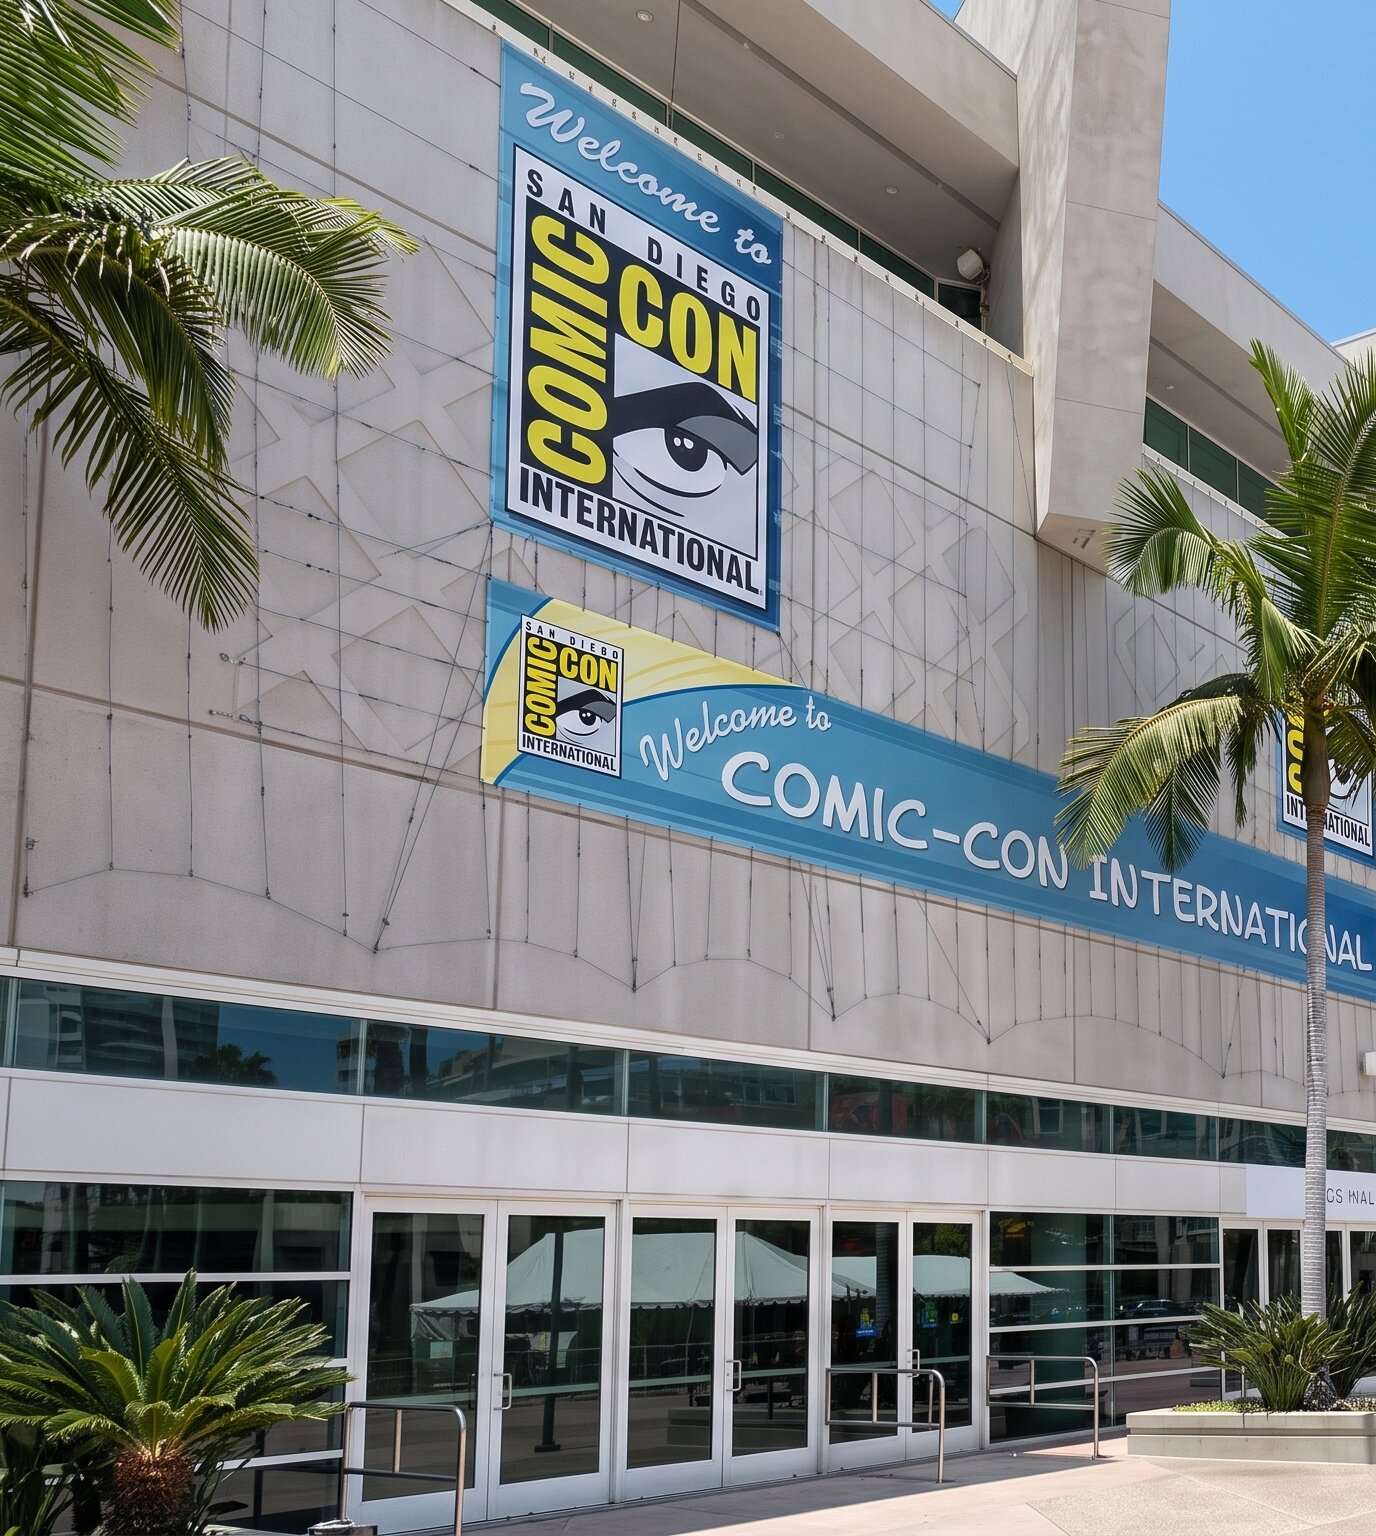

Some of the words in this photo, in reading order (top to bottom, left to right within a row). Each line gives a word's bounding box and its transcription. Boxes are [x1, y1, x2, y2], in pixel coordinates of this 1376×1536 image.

[520, 82, 720, 233] Welcome
[734, 228, 771, 266] to
[526, 168, 606, 235] SAN
[646, 235, 761, 322] DIEGO
[526, 214, 610, 486] COMIC
[618, 263, 757, 404] CON
[519, 465, 760, 595] INTERNATIONAL
[524, 636, 558, 737] COMIC
[525, 621, 556, 640] SAN
[559, 646, 617, 693] CON
[522, 733, 617, 772] INTERNATIONAL
[639, 700, 797, 781] Welcome
[805, 695, 832, 732] to
[721, 751, 1068, 890] COMIC-CON
